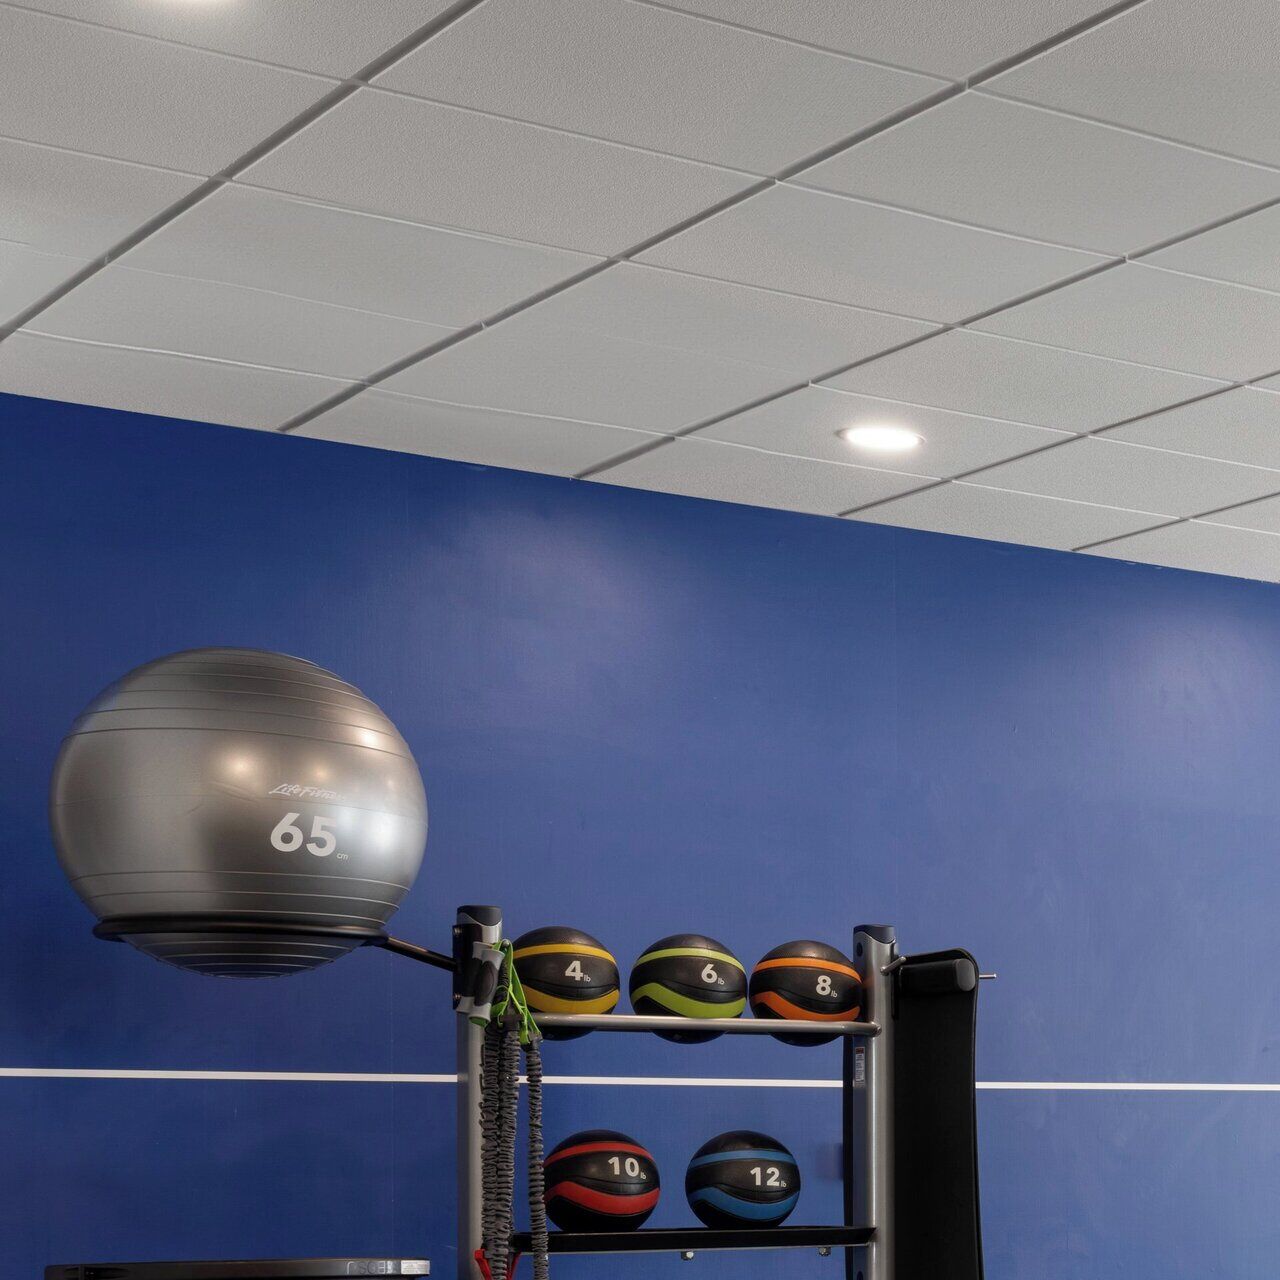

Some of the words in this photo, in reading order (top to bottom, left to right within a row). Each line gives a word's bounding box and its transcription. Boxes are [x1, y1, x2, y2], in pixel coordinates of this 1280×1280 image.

[270, 812, 337, 857] 65
[565, 960, 583, 981] 4
[701, 963, 718, 984] 6
[815, 975, 832, 996] 8
[608, 1156, 640, 1178] 10
[750, 1166, 780, 1188] 12
